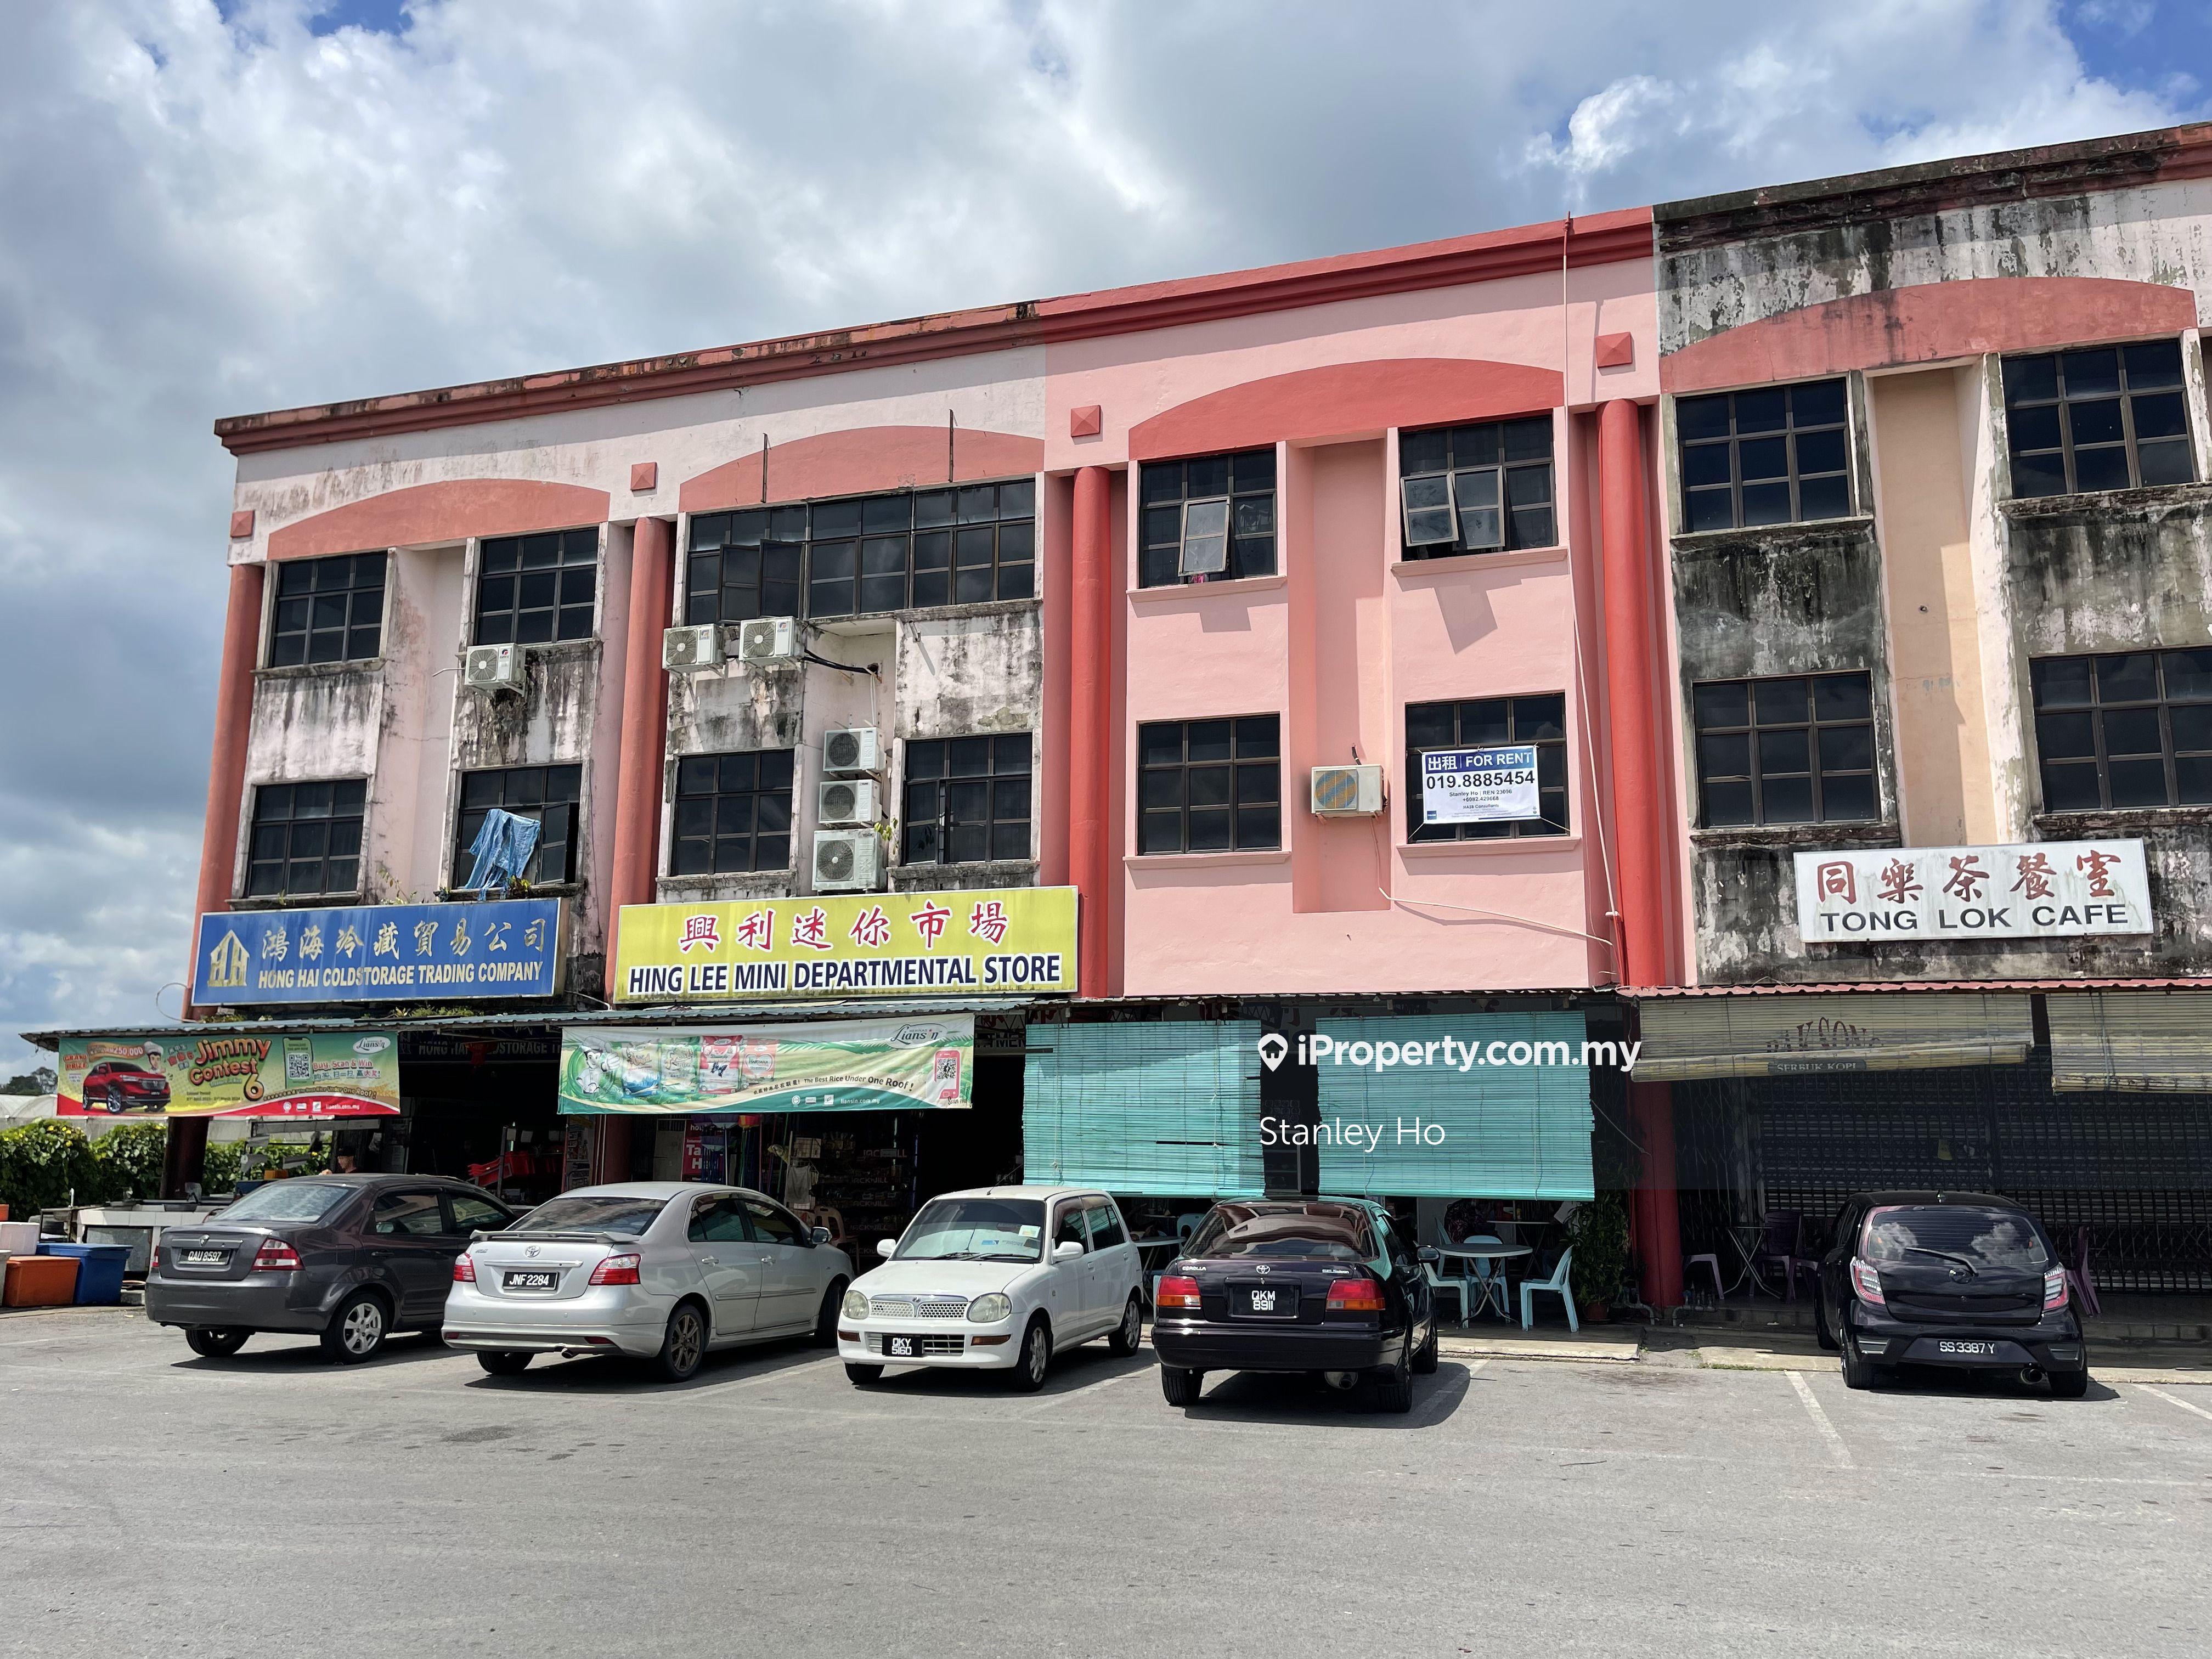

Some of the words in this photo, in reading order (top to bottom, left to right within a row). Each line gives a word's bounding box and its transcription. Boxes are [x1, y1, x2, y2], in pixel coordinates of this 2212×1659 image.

[1427, 755, 1458, 771] 出租
[1465, 754, 1493, 768] FOR
[1497, 752, 1532, 765] RENT
[1426, 770, 1535, 789] 019.8885454
[1816, 850, 2121, 904] 同樂茶餐室
[680, 901, 1008, 952] 興利迷你市場
[1820, 911, 1917, 932] TONG
[1938, 907, 2013, 928] LOK
[2032, 904, 2128, 926] CAFE
[262, 918, 546, 962] 鴻海冷藏貿易公司
[258, 969, 294, 989] HONG
[297, 968, 319, 988] HAI
[323, 965, 415, 986] COLDSTORAGE
[418, 963, 475, 984] TRADING
[478, 961, 543, 983] COMPANY
[629, 966, 682, 993] HING
[690, 965, 727, 991] LEE
[735, 963, 786, 990] MINI
[794, 957, 977, 988] DEPARTMENTAL
[984, 955, 1060, 983] STORE
[195, 1038, 272, 1064] Jimmy
[419, 1041, 448, 1055] HONG
[190, 1058, 257, 1085] Contest
[244, 1073, 264, 1101] 6
[868, 1076, 884, 1085] One
[188, 1250, 204, 1261] QAU
[202, 1251, 222, 1262] 8597
[509, 1274, 527, 1285] JNF
[526, 1274, 550, 1285] 2284
[1251, 1290, 1276, 1301] QKM
[1253, 1300, 1273, 1311] 8911
[891, 1346, 912, 1355] 5160
[1940, 1341, 1955, 1352] SS
[1956, 1342, 1985, 1353] 3387
[1987, 1343, 1995, 1354] Y
